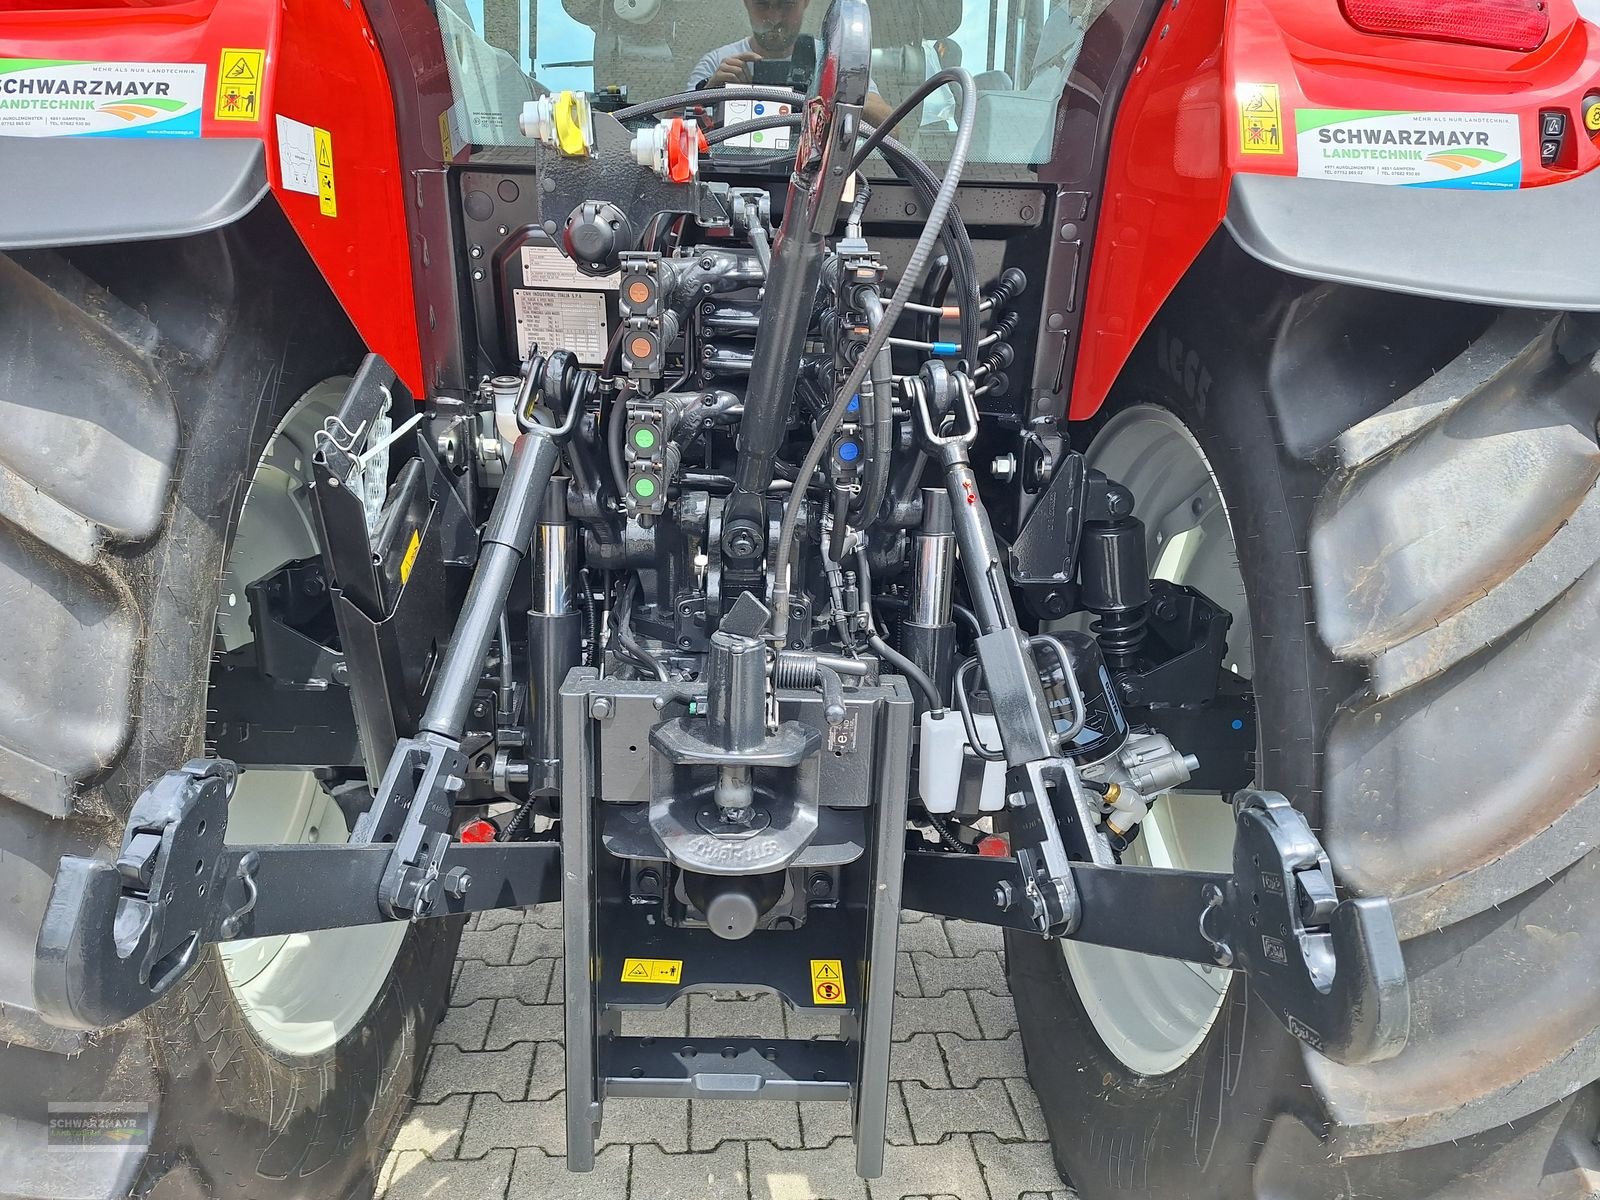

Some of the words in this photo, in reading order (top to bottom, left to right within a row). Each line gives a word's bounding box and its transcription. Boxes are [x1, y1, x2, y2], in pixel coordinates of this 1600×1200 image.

[0, 78, 170, 96] CHWARZMAYR
[0, 99, 96, 111] ANDTECHNIK
[1319, 128, 1489, 146] SCHWARZMAYR
[1323, 148, 1423, 161] LANDTECHNIK
[1105, 681, 1119, 716] WABCO
